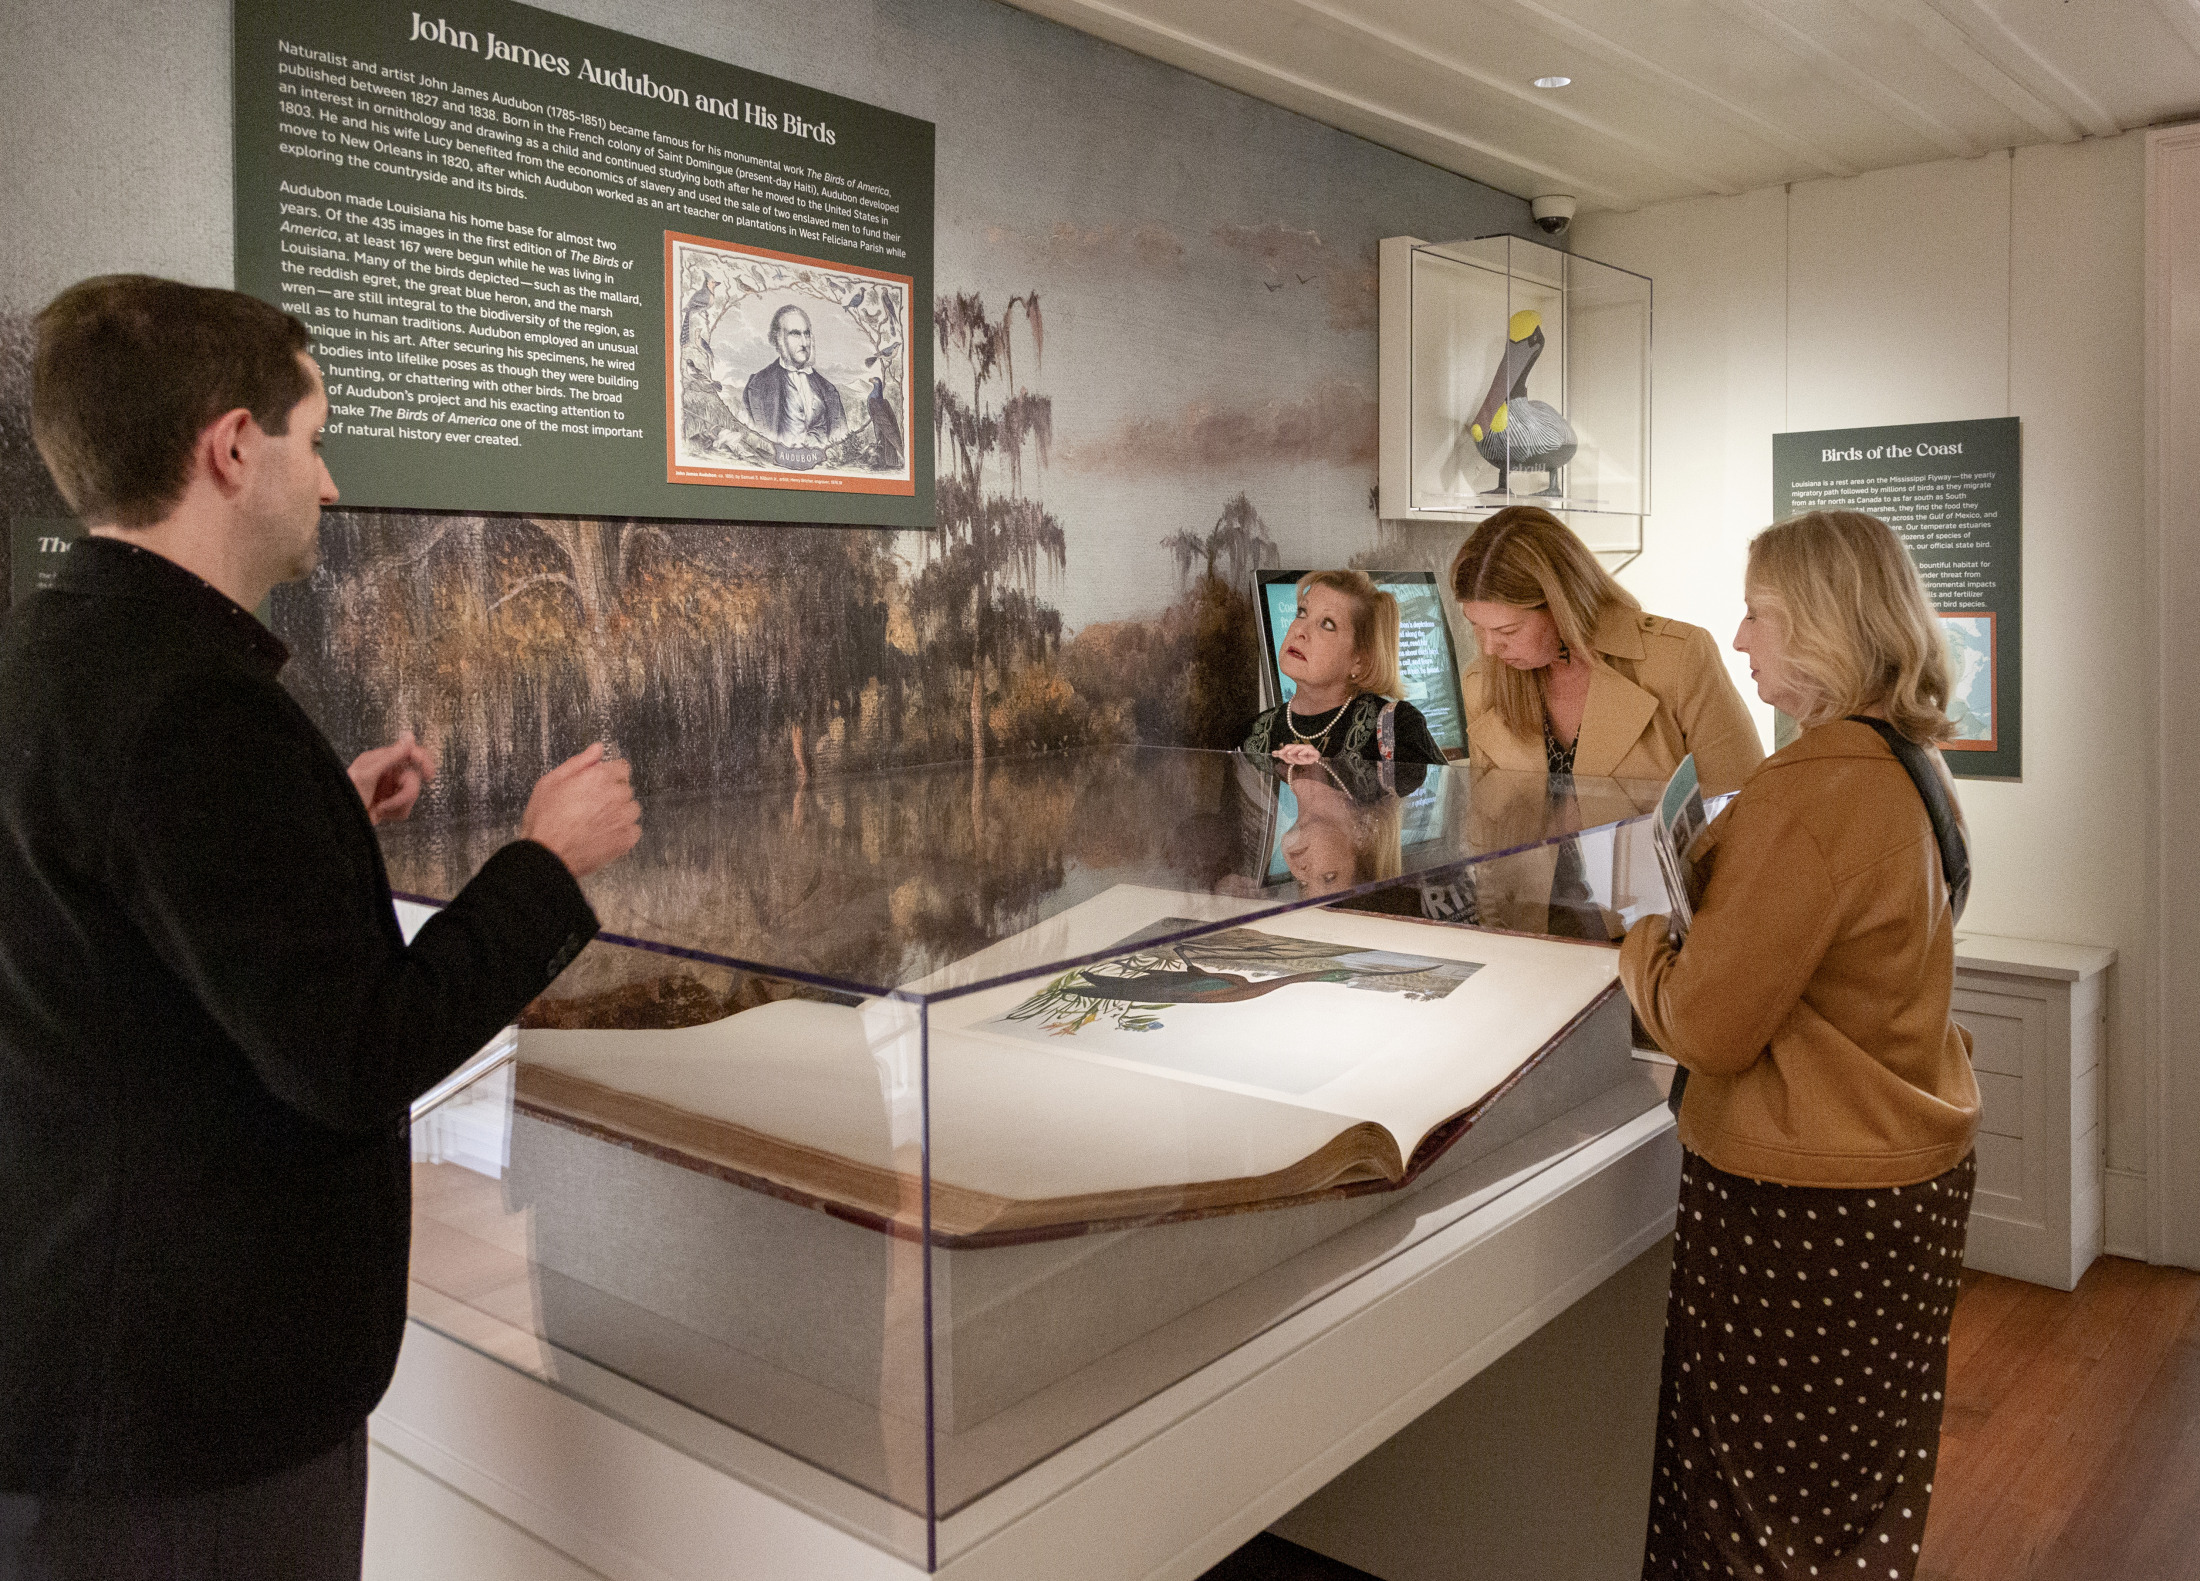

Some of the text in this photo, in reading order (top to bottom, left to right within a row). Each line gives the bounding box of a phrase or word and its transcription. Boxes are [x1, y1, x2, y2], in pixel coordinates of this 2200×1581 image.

[410, 12, 836, 145] John James Audubon and His Birds
[279, 39, 347, 67] Naturalist
[352, 60, 377, 74] and
[381, 67, 415, 84] artist
[419, 74, 448, 91] John
[451, 82, 489, 101] James
[492, 92, 543, 114] Audubon
[609, 120, 650, 139] became
[652, 130, 689, 149] famous
[692, 140, 706, 152] for
[708, 144, 722, 156] his
[724, 150, 781, 171] monumental
[783, 164, 804, 176] work
[807, 168, 822, 180] The
[824, 172, 845, 186] Birds
[857, 179, 891, 198] America,
[279, 143, 527, 199] exploring the countryside and its birds.
[279, 180, 617, 251] Audubon made Louisiana his home base for almost two
[280, 203, 634, 270] years. Of the 435 images in the first edition of The Birds of
[281, 302, 639, 355] well as to human traditions. Audubon employed an unusual
[329, 422, 343, 434] of
[347, 425, 395, 438] natural
[398, 427, 442, 443] history
[445, 433, 471, 443] ever
[474, 435, 522, 446] created.
[779, 451, 818, 463] AUDUBON
[1822, 443, 1963, 462] Birds of the Coast
[1840, 487, 1869, 495] followed
[1963, 482, 1991, 490] migrate
[1857, 496, 1882, 504] Canada
